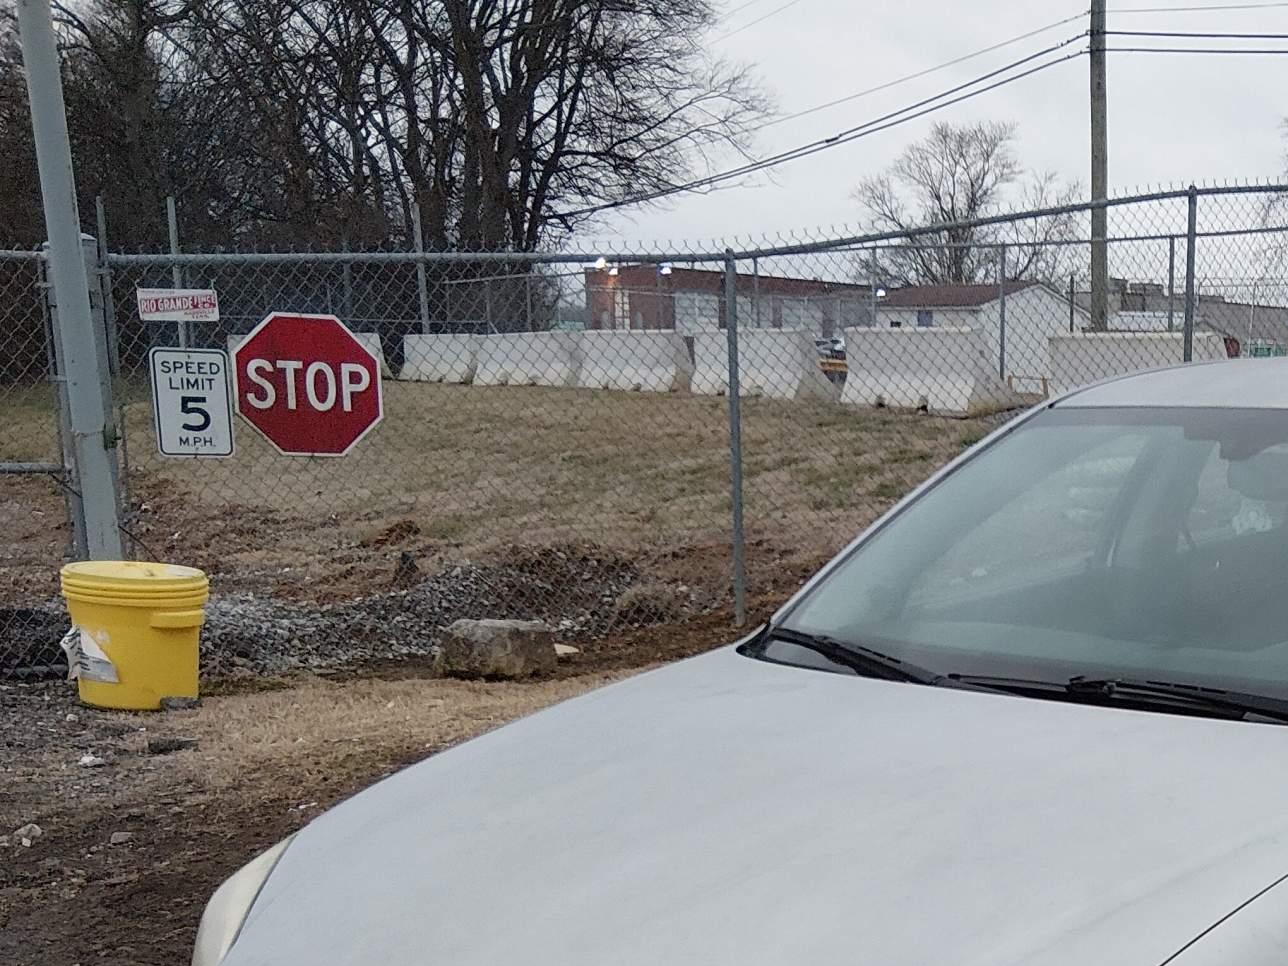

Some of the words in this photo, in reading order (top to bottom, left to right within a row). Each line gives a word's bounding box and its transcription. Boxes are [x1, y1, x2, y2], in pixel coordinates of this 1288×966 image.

[141, 298, 157, 313] RIO
[157, 297, 193, 312] GRANDE
[160, 360, 220, 375] SPEED
[168, 376, 216, 391] LIMIT
[246, 358, 371, 412] STOP
[180, 395, 211, 432] 5
[178, 436, 217, 448] M.P.H.
